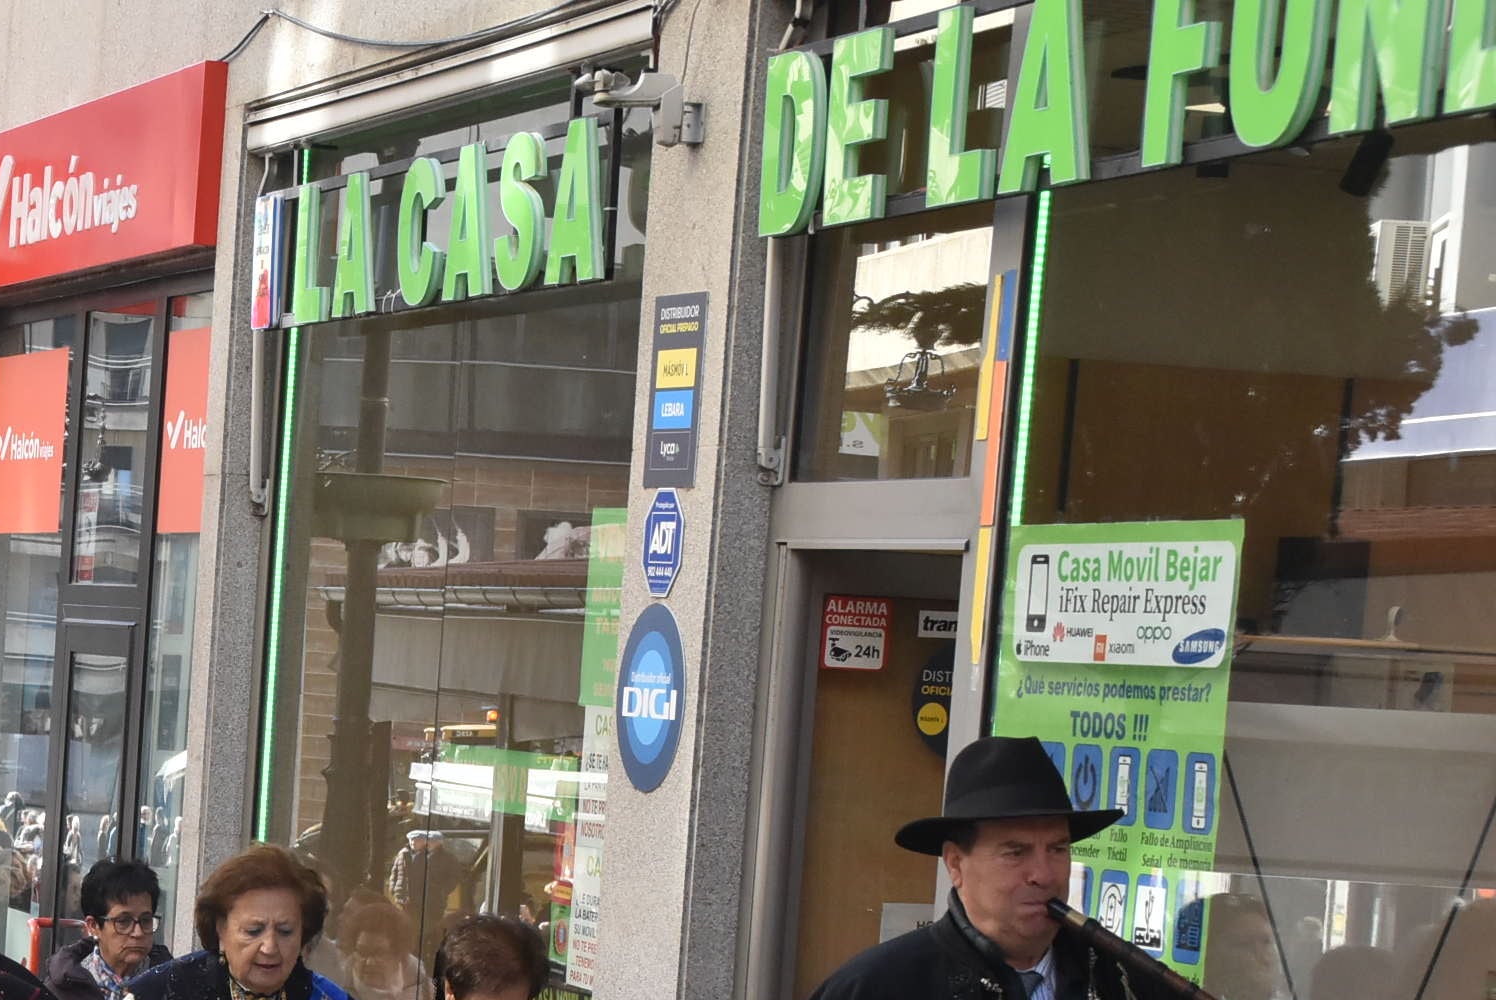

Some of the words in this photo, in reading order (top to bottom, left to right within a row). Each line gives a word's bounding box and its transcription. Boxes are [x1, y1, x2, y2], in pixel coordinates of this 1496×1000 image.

[758, 26, 894, 236] DE
[926, 0, 1090, 206] LA
[293, 171, 376, 325] LA
[397, 118, 605, 307] CASA
[661, 305, 699, 320] DISTRIBUIDOR
[661, 402, 684, 417] LEBARA
[11, 432, 39, 460] Halcón
[649, 522, 676, 555] ADT
[1058, 551, 1101, 582] Casa
[1108, 547, 1160, 582] Movil
[1166, 546, 1222, 591] Bejar
[826, 600, 888, 615] ALARMA
[1059, 587, 1087, 613] iFix
[1091, 586, 1140, 621] Repair
[1142, 589, 1206, 622] Express
[826, 615, 887, 626] CONECTADA
[830, 629, 882, 638] VIDEOVIGILANCIA
[1066, 628, 1093, 638] HUAWEI
[854, 645, 880, 659] 24h
[1024, 641, 1050, 657] iPhone
[1178, 636, 1223, 654] SAMSUNG
[922, 669, 953, 682] DIST
[1017, 676, 1044, 698] ¿Qué
[1047, 677, 1100, 697] servicios
[1102, 679, 1156, 702] podemos
[1159, 682, 1212, 705] prestar?
[622, 686, 677, 720] DIGI
[1070, 711, 1126, 740] TODOS
[1133, 714, 1149, 742] !!!
[1110, 828, 1128, 843] Fallo
[1140, 832, 1159, 847] Fallo
[1160, 834, 1169, 847] de
[1070, 845, 1100, 861] ncender
[1167, 854, 1178, 868] de
